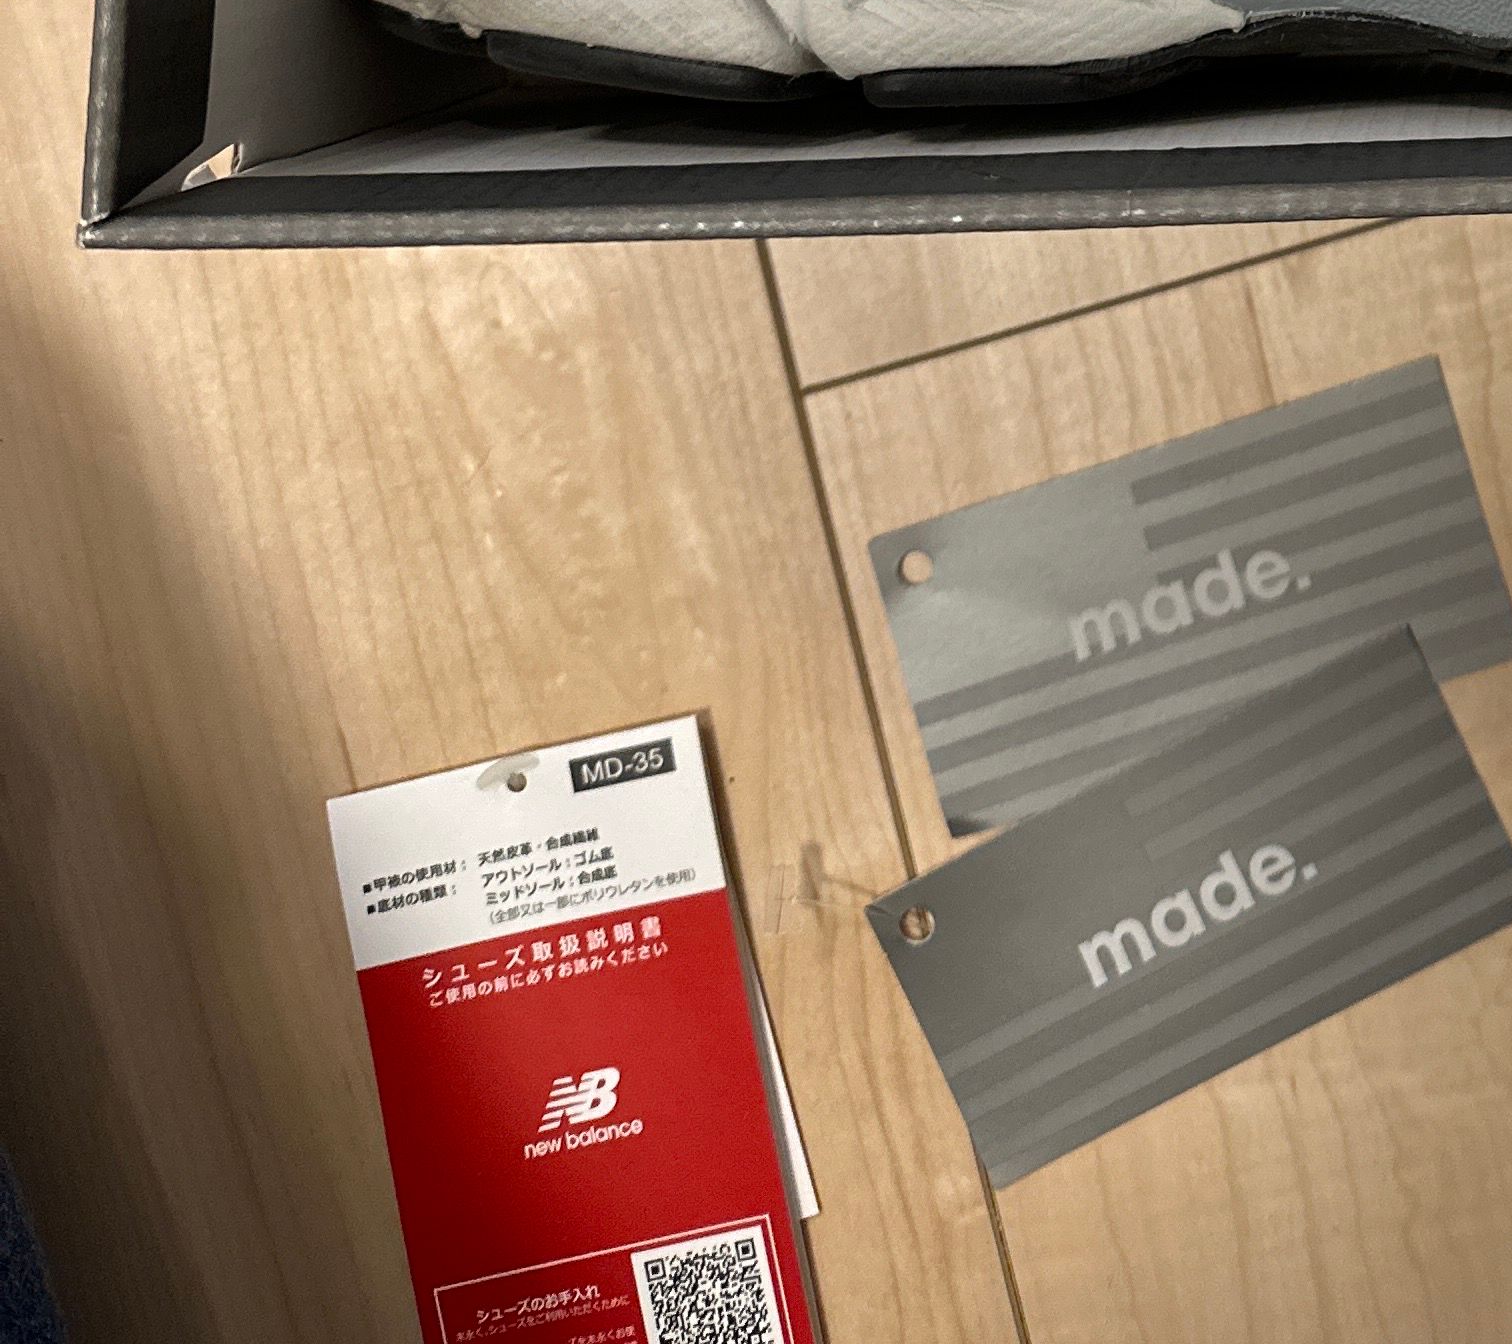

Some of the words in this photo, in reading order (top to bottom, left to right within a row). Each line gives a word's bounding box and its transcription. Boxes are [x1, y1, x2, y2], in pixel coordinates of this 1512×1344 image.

[1067, 547, 1313, 662] made.
[580, 747, 664, 786] MD-35
[1078, 840, 1320, 990] made.
[421, 915, 663, 989] シューズ取扱説明書
[428, 941, 669, 1008] ご使用の前に必ずお読みください
[523, 1135, 563, 1161] new
[564, 1118, 644, 1151] balance
[476, 1284, 601, 1325] シューズのお手入れ
